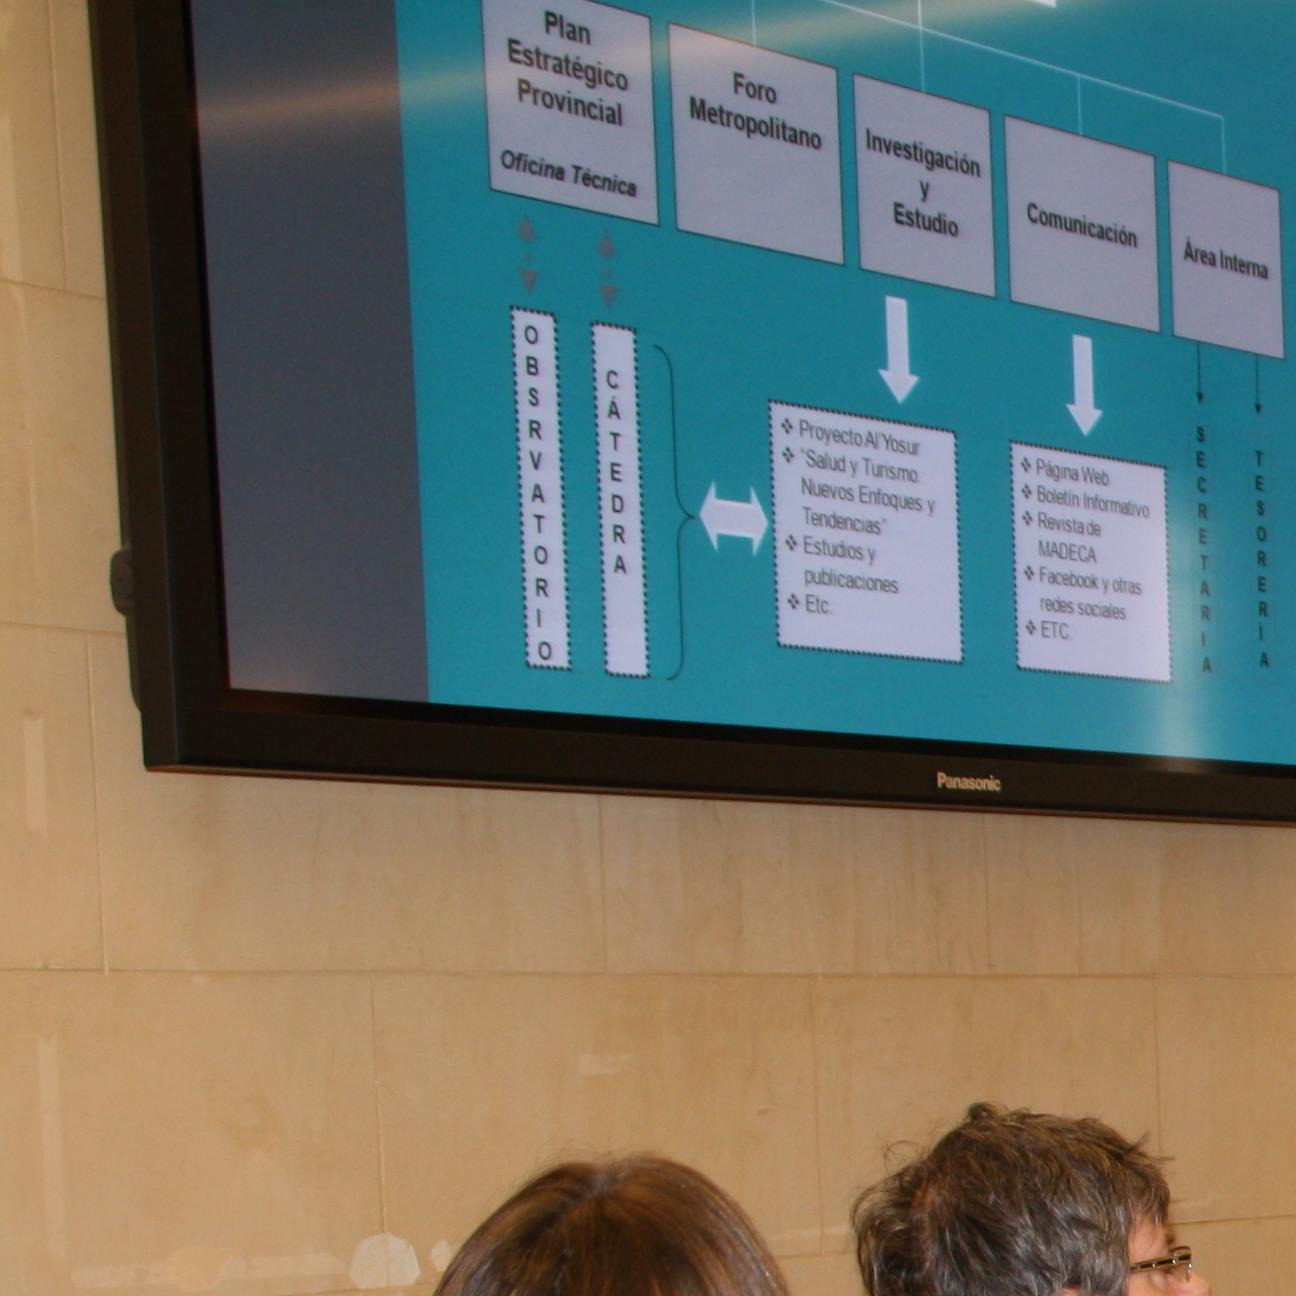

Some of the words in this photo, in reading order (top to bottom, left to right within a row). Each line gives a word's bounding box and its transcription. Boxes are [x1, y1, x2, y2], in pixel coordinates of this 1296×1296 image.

[544, 10, 592, 46] Plan
[507, 37, 629, 91] Estratégico
[517, 78, 623, 127] Provincial
[732, 72, 777, 104] Foro
[689, 96, 822, 150] Metropolitano
[865, 129, 980, 178] Investigación
[500, 149, 566, 181] Oficina
[572, 164, 637, 198] Técnica
[919, 179, 930, 201] y
[893, 203, 959, 237] Estudio
[1027, 203, 1138, 249] Comunicación
[1183, 236, 1217, 268] Área
[1220, 249, 1269, 280] Interna
[799, 418, 863, 447] Proyecto
[850, 461, 858, 478] y
[1036, 457, 1079, 482] Página
[1082, 466, 1110, 486] Web
[801, 477, 855, 502] Nuevos
[858, 485, 923, 512] Enfoques
[927, 499, 935, 517] y
[1083, 493, 1150, 518] Informativo
[1037, 511, 1084, 535] Revista
[1087, 521, 1102, 537] de
[803, 535, 864, 560] Estudios
[868, 548, 876, 565] y
[1038, 540, 1097, 563] MADECA
[804, 567, 899, 595] publicaciones
[1039, 566, 1098, 590] Facebook
[1102, 578, 1110, 594] y
[1112, 578, 1143, 596] otras
[1040, 597, 1074, 615] redes
[1078, 601, 1127, 621] sociales
[937, 771, 1001, 792] Panasonic
